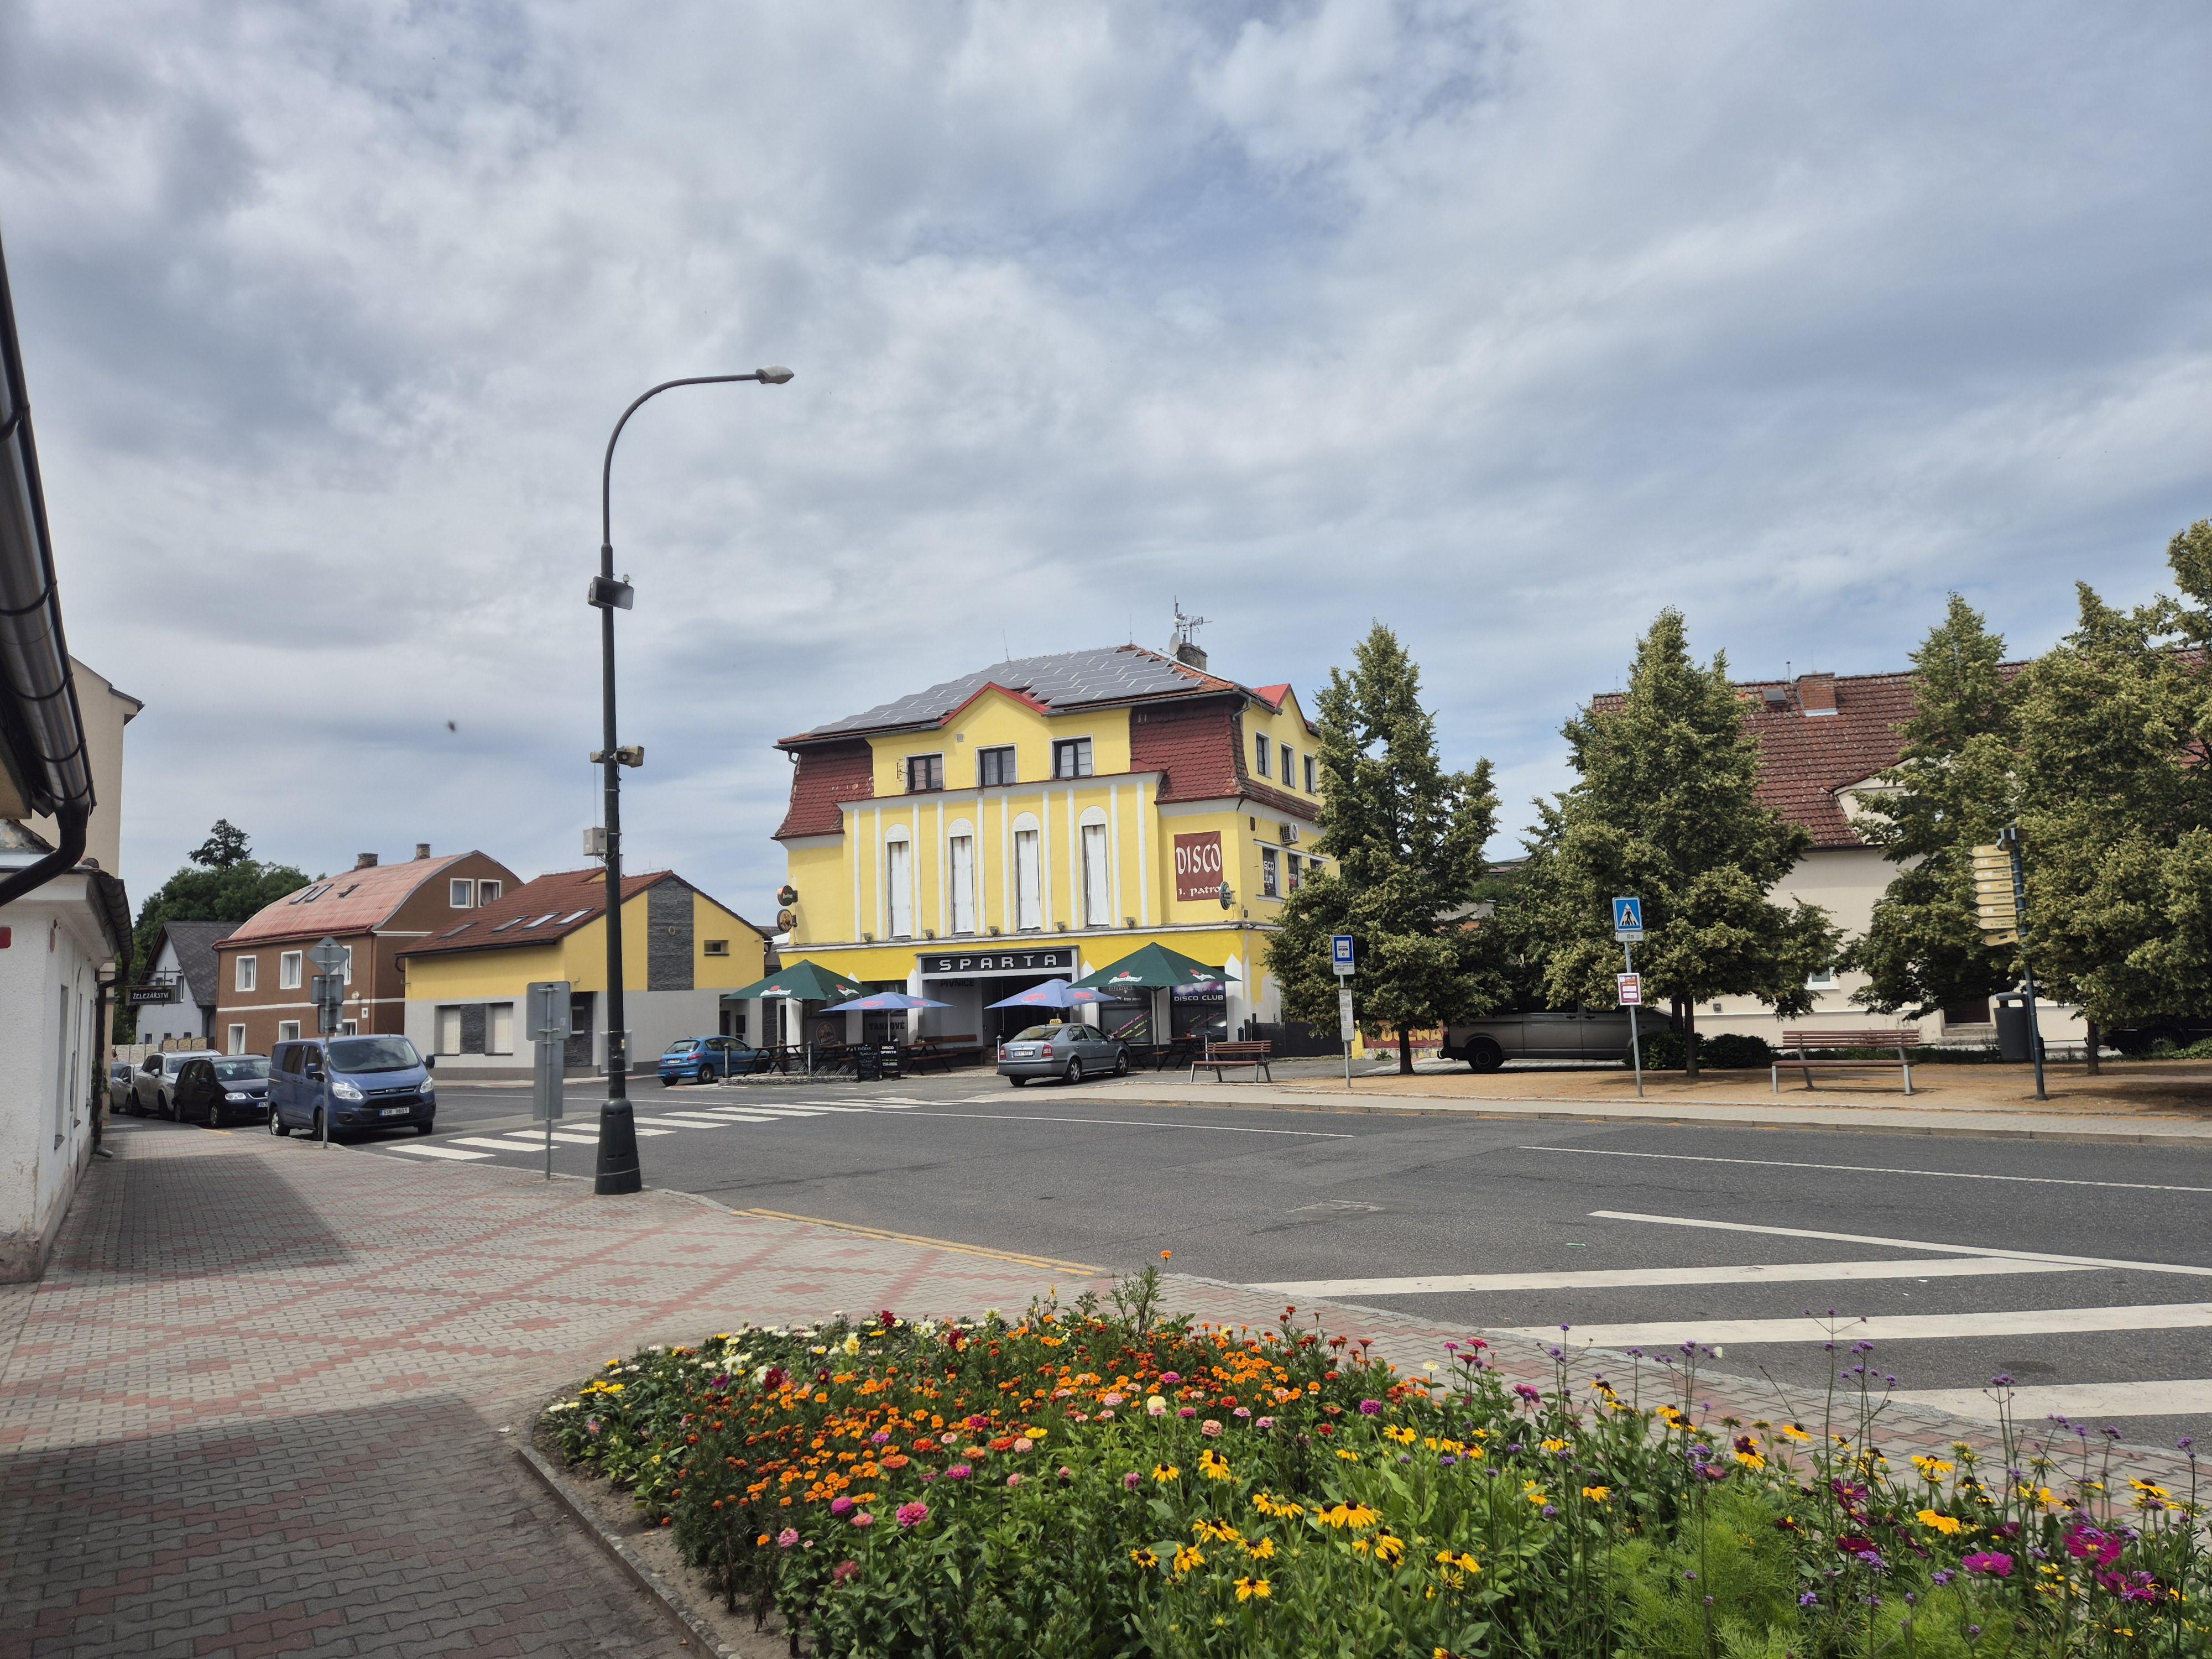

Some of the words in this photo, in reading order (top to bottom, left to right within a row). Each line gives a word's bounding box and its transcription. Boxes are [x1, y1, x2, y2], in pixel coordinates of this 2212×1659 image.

[1176, 843, 1221, 874] DISCO
[1190, 886, 1222, 896] patro
[939, 954, 1057, 971] SPARTA
[133, 991, 169, 999] ŽELEZÁŘSTVÍ
